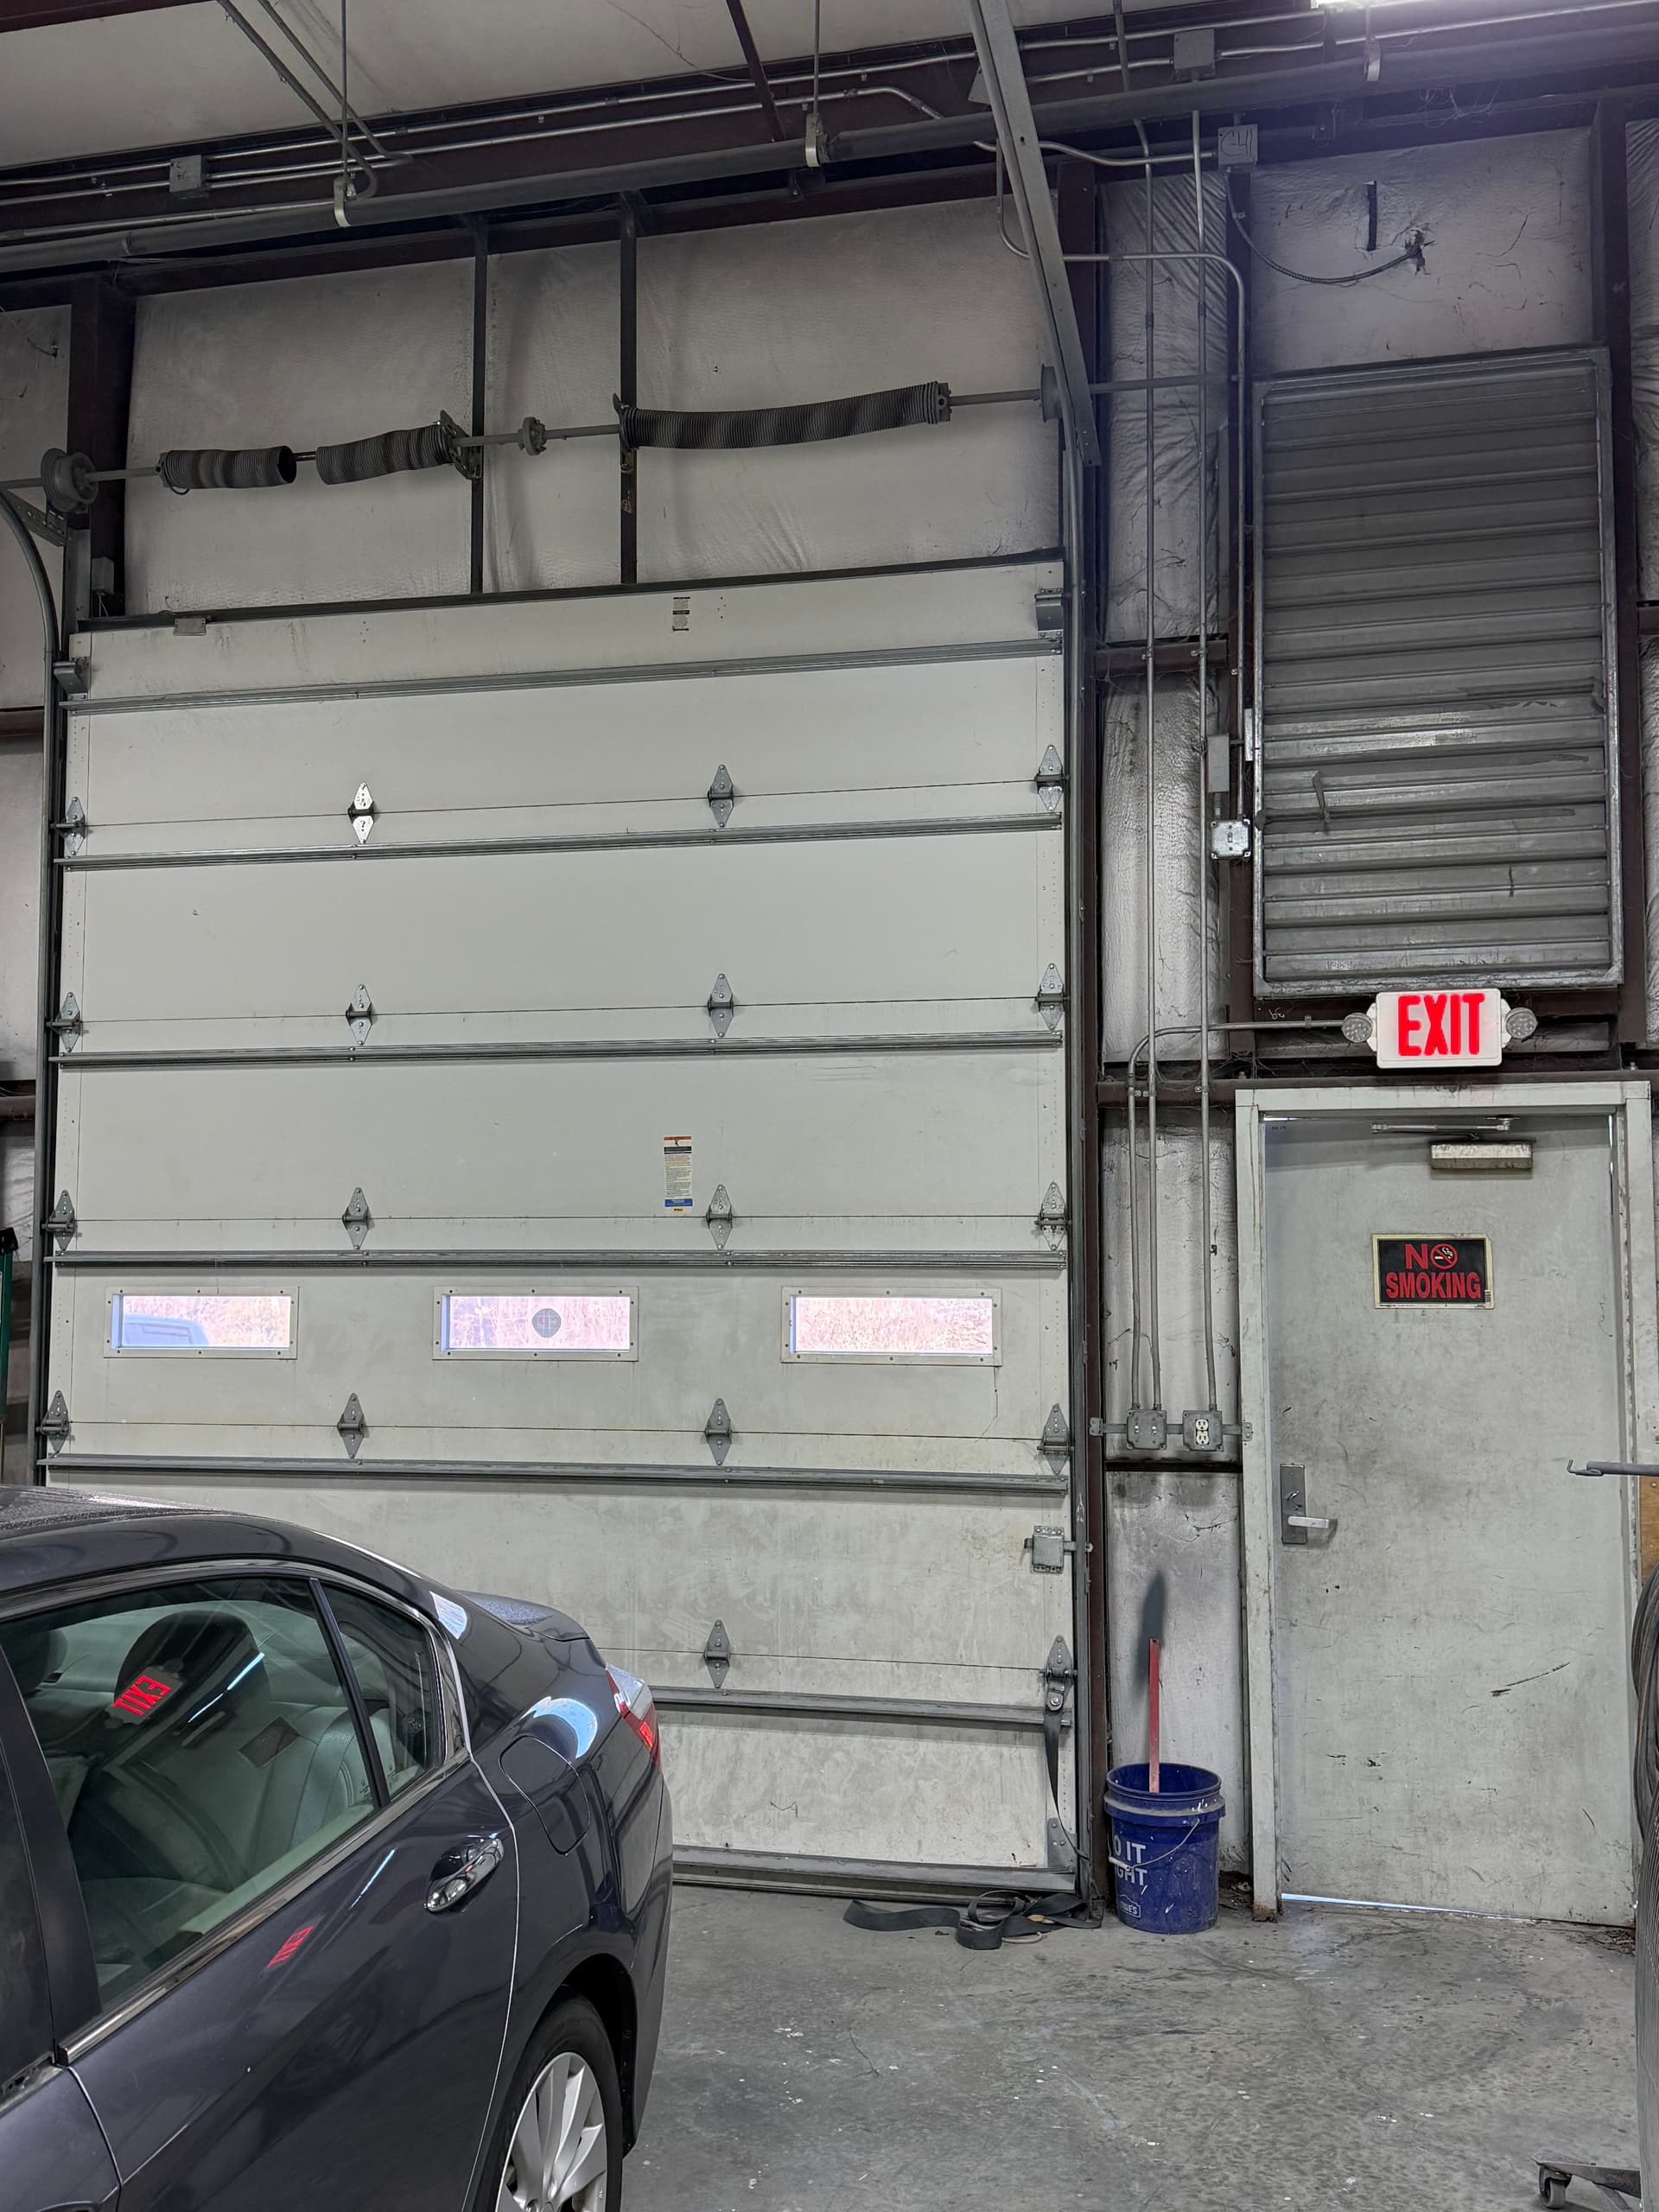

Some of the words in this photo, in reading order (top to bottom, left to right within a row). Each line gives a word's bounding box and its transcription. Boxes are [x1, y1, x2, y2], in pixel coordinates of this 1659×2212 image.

[1397, 993, 1485, 1057] EXIT
[1385, 1271, 1481, 1300] SMOKING
[1126, 1841, 1146, 1864] IT
